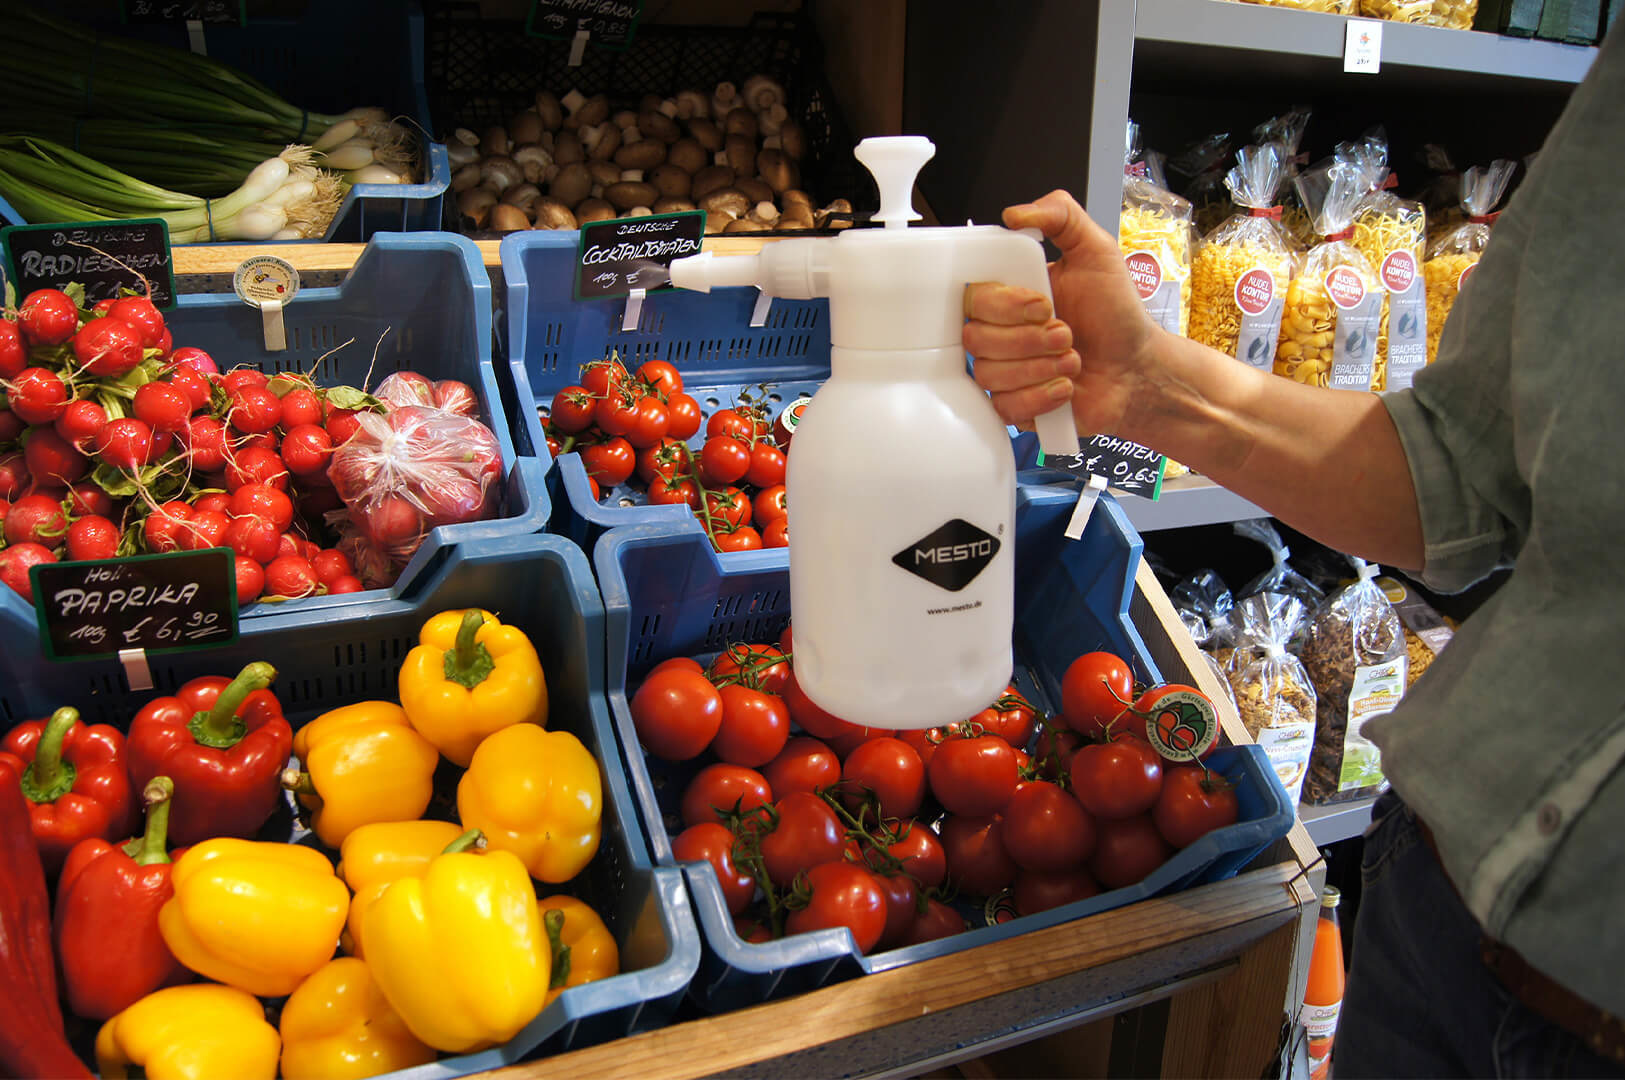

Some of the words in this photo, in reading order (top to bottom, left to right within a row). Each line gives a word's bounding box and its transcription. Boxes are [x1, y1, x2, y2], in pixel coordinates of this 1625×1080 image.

[617, 220, 679, 235] DEUTSCHE
[582, 238, 704, 265] COCKTAILTOMATEN
[20, 250, 170, 279] RADIESCHEN
[1130, 260, 1155, 274] NUDEL
[1390, 257, 1411, 271] NUDEL
[1129, 271, 1157, 286] ONTOR
[1386, 266, 1412, 281] KONTOR
[1248, 275, 1270, 291] NUDEL
[1332, 281, 1362, 297] KONTOR
[1241, 284, 1270, 302] KONTOR
[1391, 355, 1424, 365] TRADITION
[1334, 375, 1369, 386] TRADITION
[1089, 433, 1163, 463] TOMATEN
[915, 539, 991, 565] MESTO
[54, 582, 200, 617] PAPRIKA
[926, 600, 983, 616] www.mesto.de
